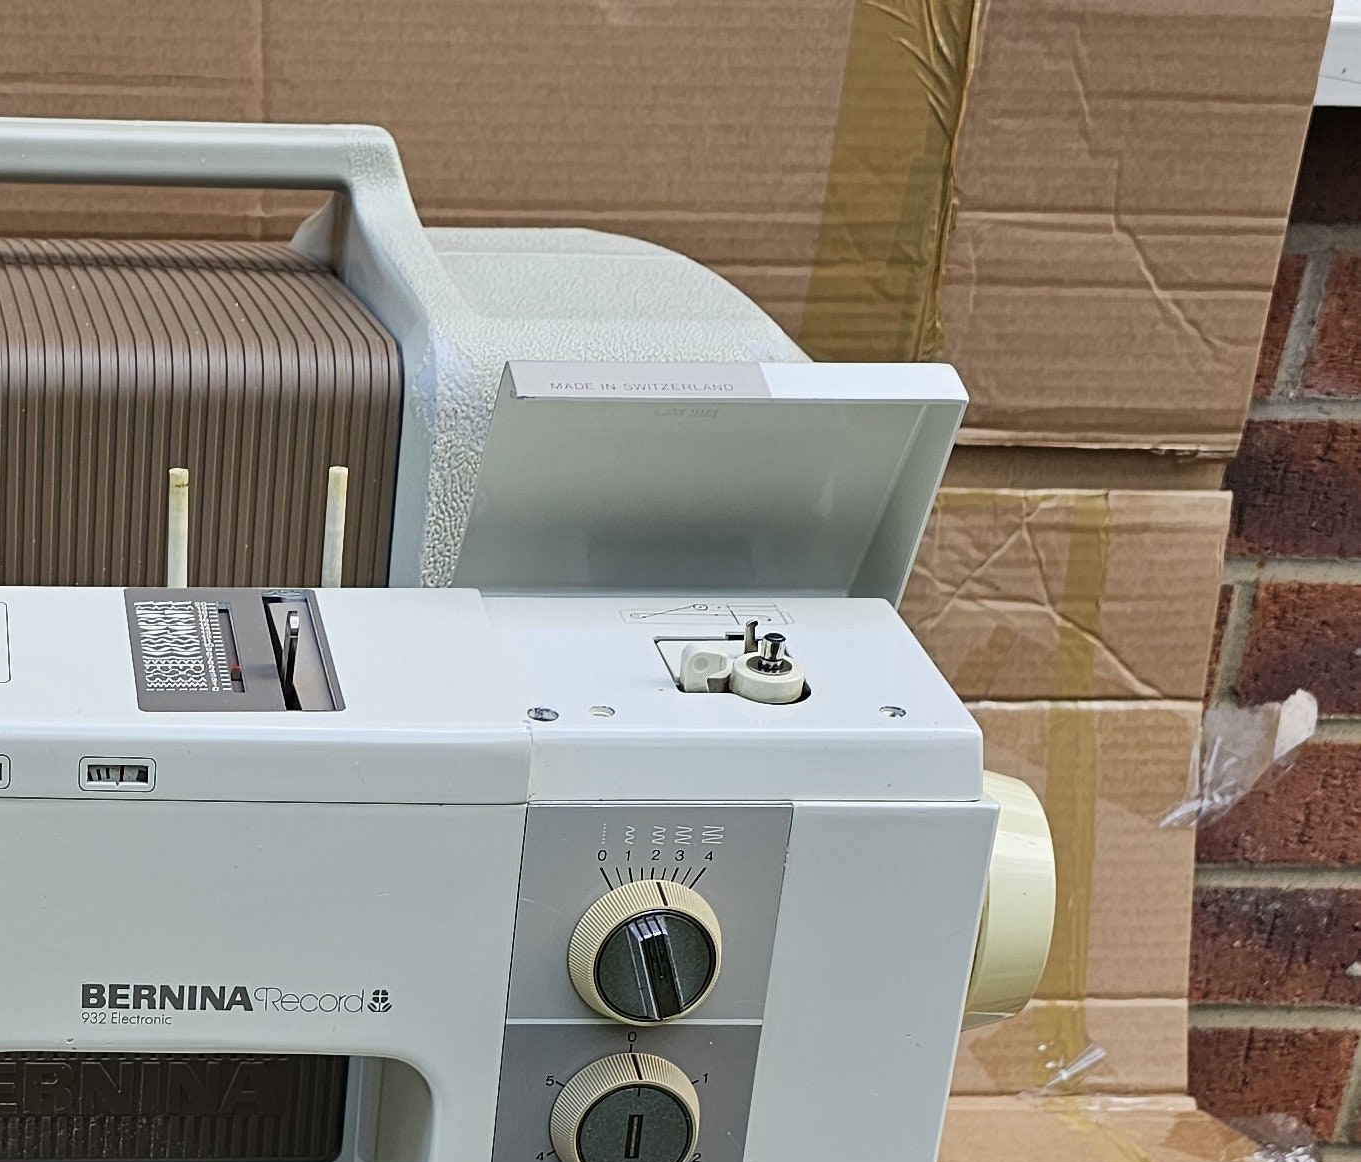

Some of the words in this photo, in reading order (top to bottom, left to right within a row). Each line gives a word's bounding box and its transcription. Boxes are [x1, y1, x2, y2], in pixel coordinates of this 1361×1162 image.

[550, 382, 595, 391] MADE
[601, 383, 616, 391] IN
[623, 382, 735, 392] SWITZERLAND
[597, 849, 607, 862] 0
[625, 850, 631, 861] 1
[651, 849, 661, 861] 2
[674, 849, 685, 862] 3
[704, 850, 714, 862] 4
[81, 983, 254, 1012] BERNINA
[254, 988, 365, 1013] Record
[81, 1011, 107, 1025] 932
[111, 1011, 173, 1026] Electronic
[627, 1031, 637, 1043] 0
[545, 1075, 555, 1087] 5
[701, 1073, 710, 1083] 1
[536, 1151, 545, 1162] 4
